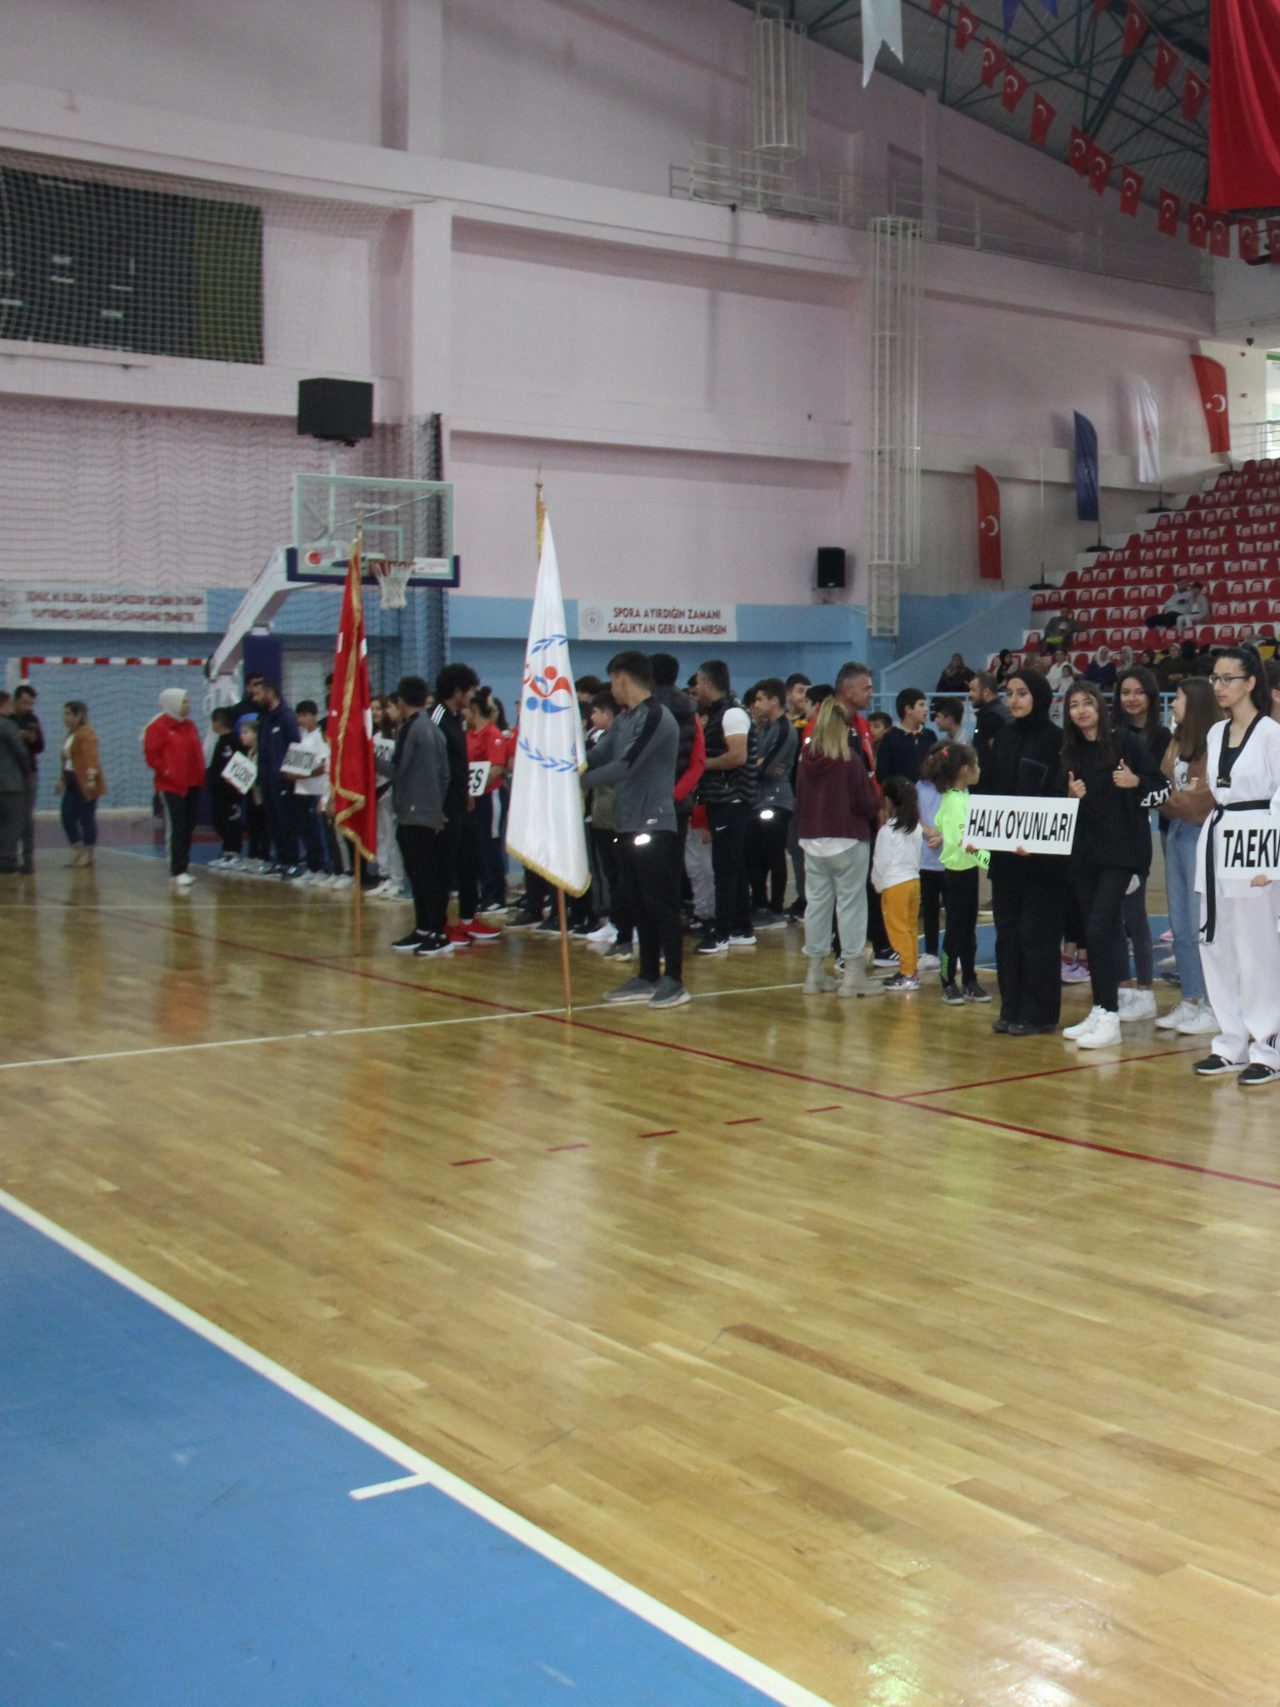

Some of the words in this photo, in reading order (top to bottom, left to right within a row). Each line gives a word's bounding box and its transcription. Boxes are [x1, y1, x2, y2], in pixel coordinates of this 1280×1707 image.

[614, 607, 641, 618] SPORA
[687, 609, 722, 620] ZAMANI
[608, 621, 656, 634] SAĞLIKTAN
[967, 808, 1005, 838] HALK
[1005, 810, 1074, 842] OYUNLARI
